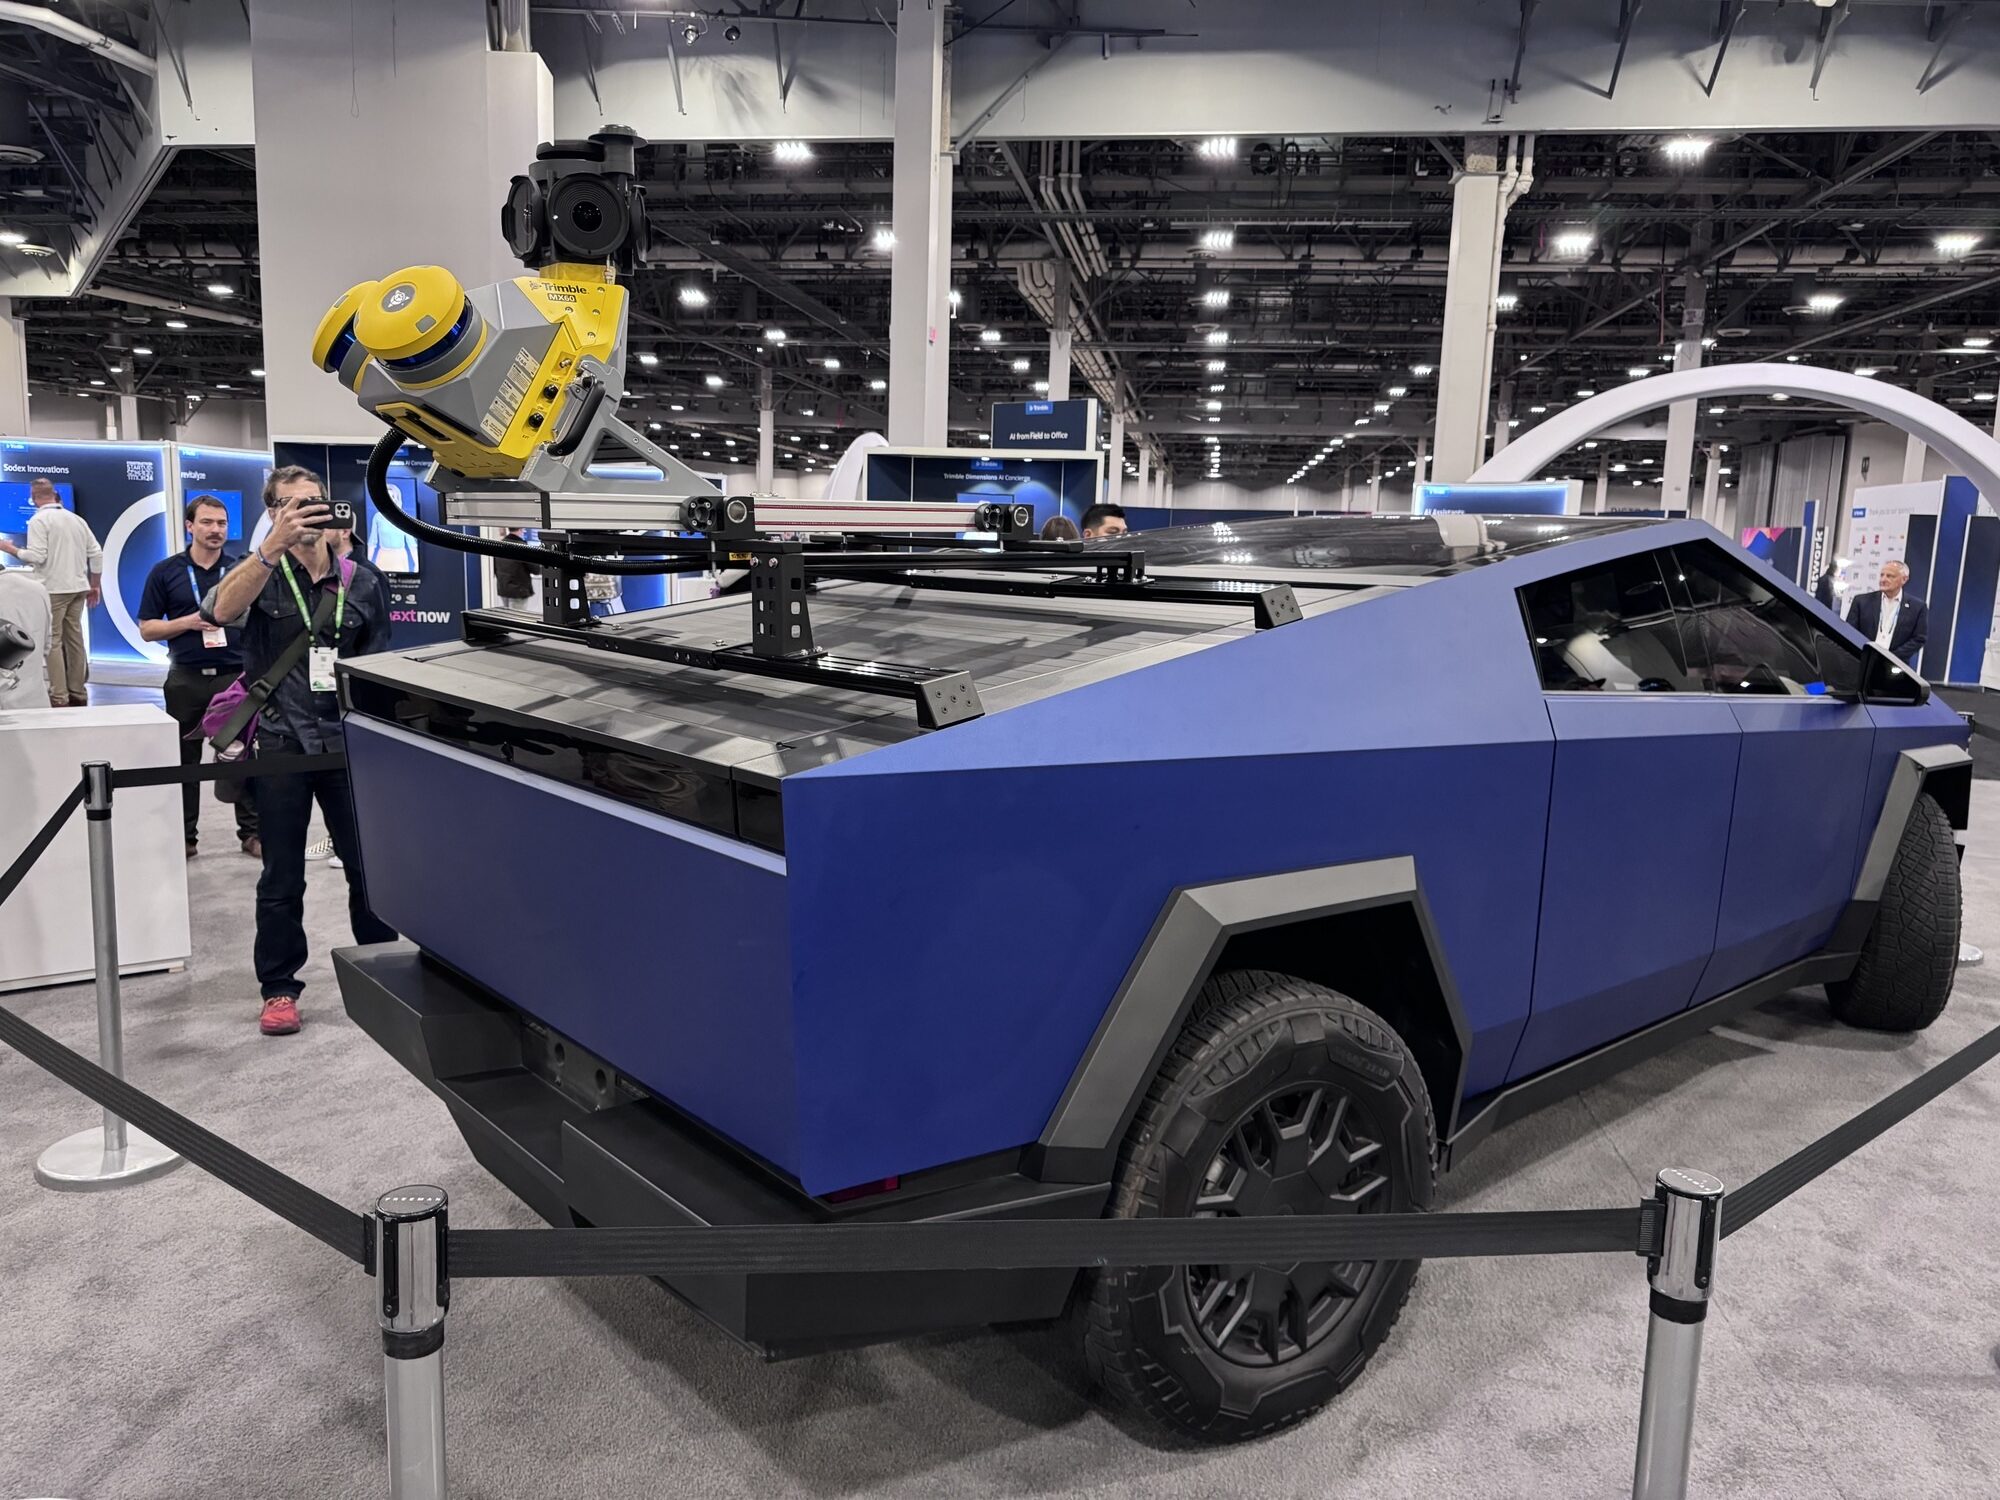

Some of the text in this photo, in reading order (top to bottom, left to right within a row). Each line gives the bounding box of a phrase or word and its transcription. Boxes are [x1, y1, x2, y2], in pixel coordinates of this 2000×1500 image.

[541, 282, 587, 295] Trimble
[548, 293, 576, 302] MX60
[1009, 433, 1015, 441] AI
[1016, 433, 1030, 441] from
[1030, 431, 1044, 440] Field
[1051, 431, 1069, 440] Office
[3, 463, 70, 475] Sodex Innovations
[943, 472, 965, 480] Trimble
